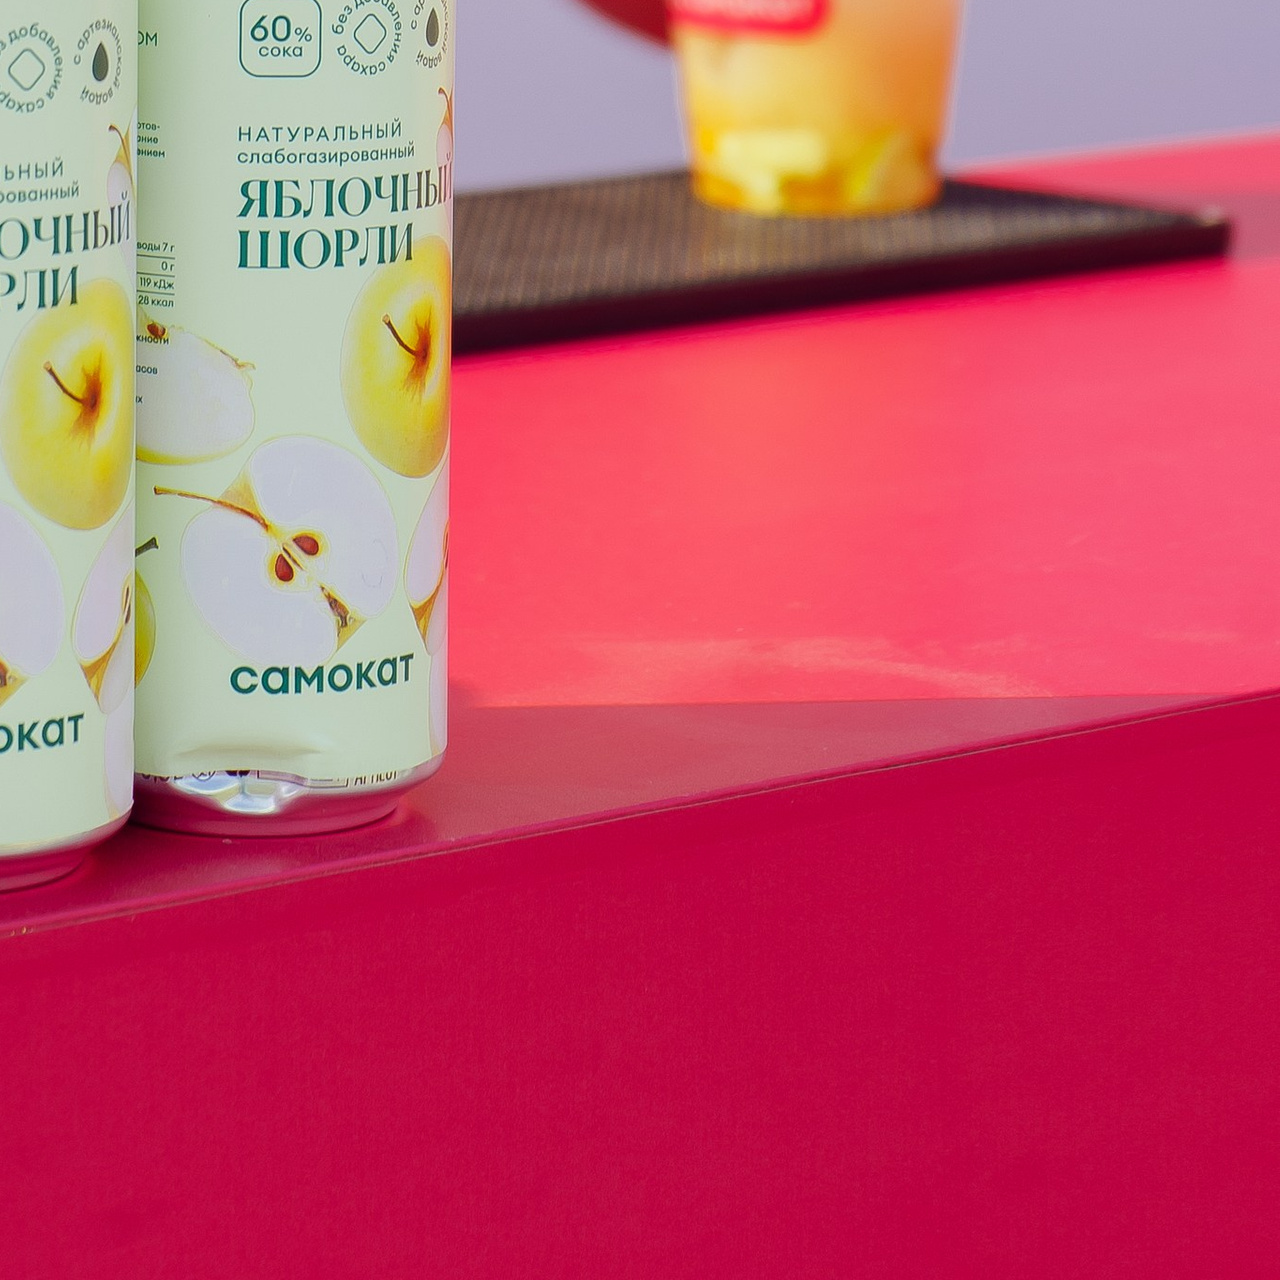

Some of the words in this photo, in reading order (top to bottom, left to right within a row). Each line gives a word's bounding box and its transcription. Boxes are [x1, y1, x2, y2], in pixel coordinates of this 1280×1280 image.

[250, 15, 312, 42] 60%
[331, 4, 353, 35] без
[410, 19, 417, 30] с
[7, 22, 63, 101] добавления
[258, 45, 303, 58] сока
[337, 44, 386, 76] сахара
[237, 117, 402, 142] НАТУРАЛЬНЫЙ
[237, 141, 415, 167] слабогазированный
[236, 151, 453, 218] ЯБЛОЧНЫЙ
[162, 242, 169, 252] 7
[170, 244, 175, 253] г
[237, 222, 414, 269] ШОРЛИ
[161, 261, 168, 271] 0
[170, 263, 175, 272] г
[139, 276, 152, 287] 119
[153, 279, 175, 290] кДж
[138, 295, 150, 306] 28
[151, 297, 175, 308] ккал
[229, 652, 415, 695] самокат
